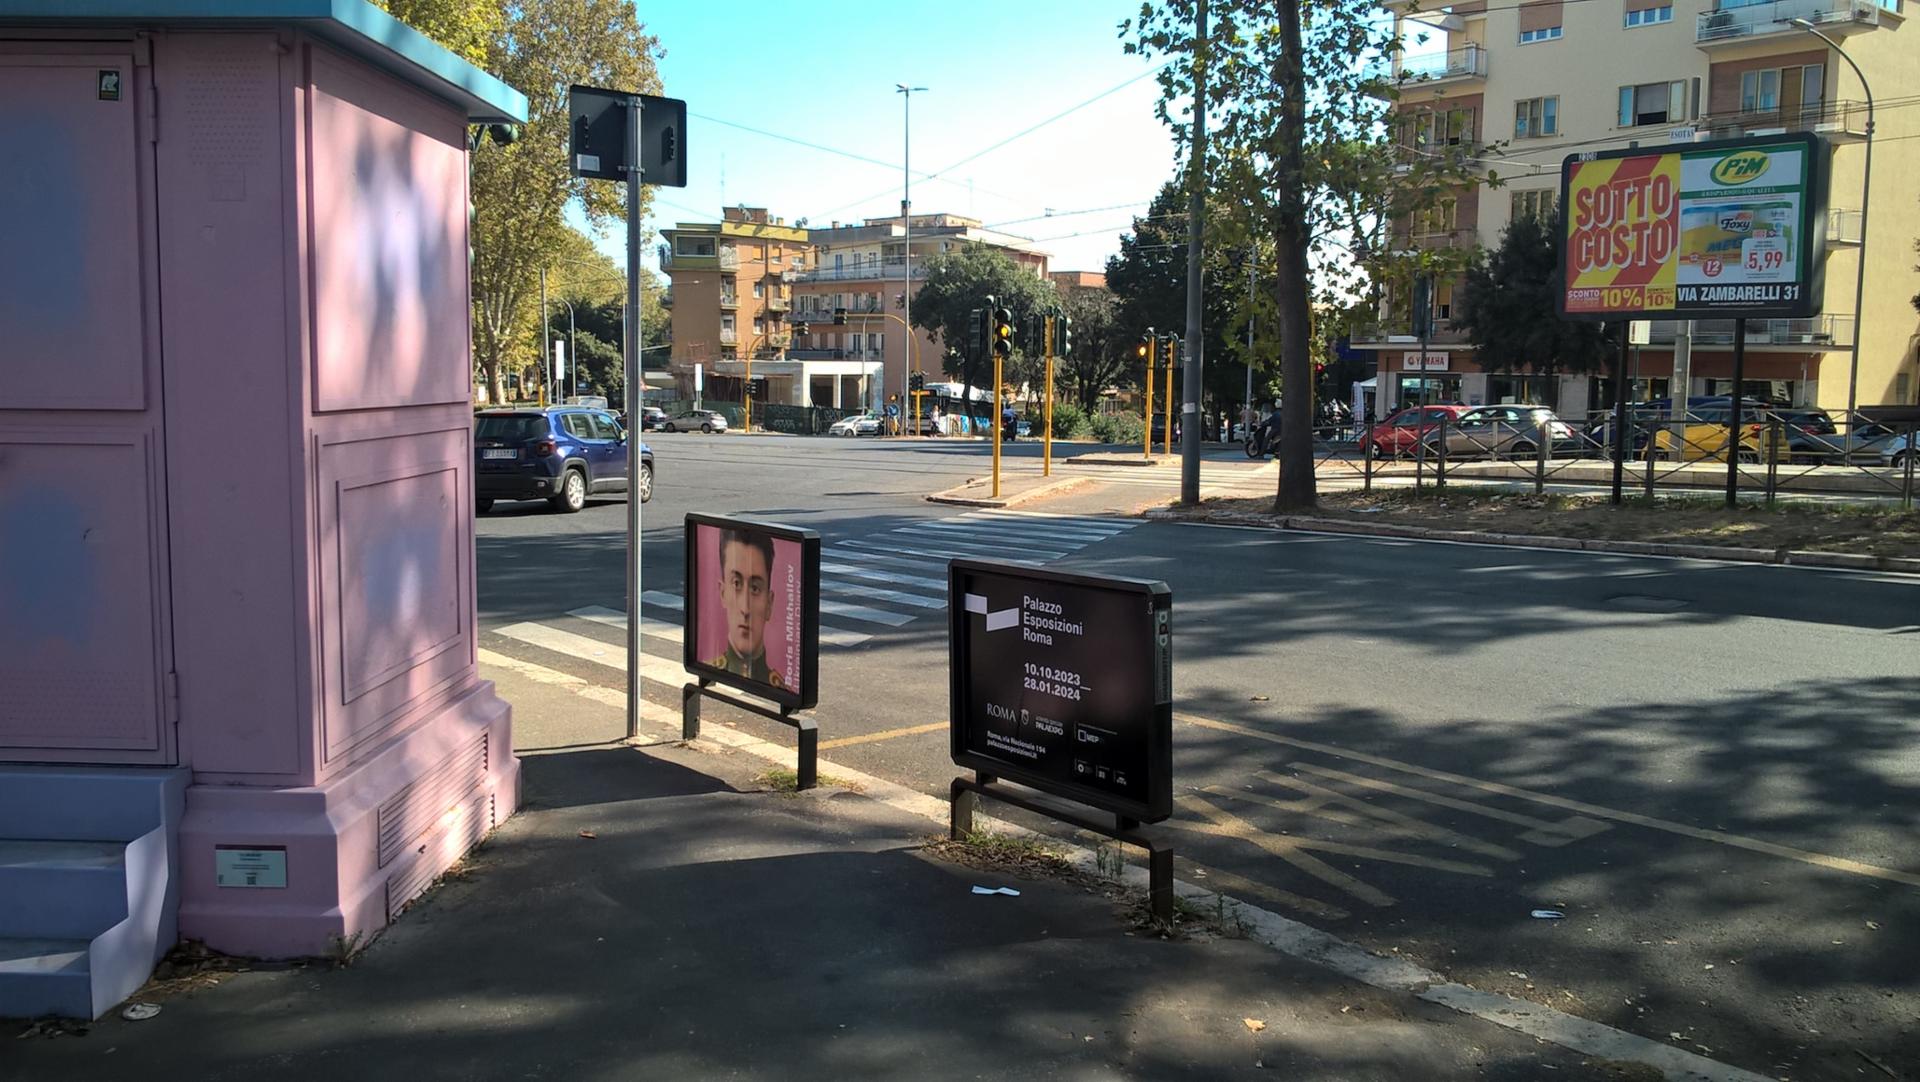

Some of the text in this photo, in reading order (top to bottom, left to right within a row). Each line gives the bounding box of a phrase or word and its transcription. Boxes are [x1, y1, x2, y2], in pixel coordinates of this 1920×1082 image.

[1575, 174, 1673, 231] SOTTO
[1721, 218, 1751, 232] Foxy
[1575, 218, 1672, 273] COSTO
[1706, 260, 1720, 272] 12
[1567, 289, 1600, 299] SCONTO
[1600, 288, 1642, 308] 10%
[1646, 293, 1673, 307] 10%
[1677, 285, 1800, 301] VIA ZAMBARELLI 31
[1416, 356, 1445, 366] YMAHA
[1023, 595, 1062, 615] Palazzo
[784, 565, 794, 688] Boris Mikhailov
[1023, 612, 1083, 636] Esposizioni
[1023, 627, 1053, 646] Roma
[1023, 677, 1081, 701] 28.01.2024
[986, 702, 1017, 723] ROMA
